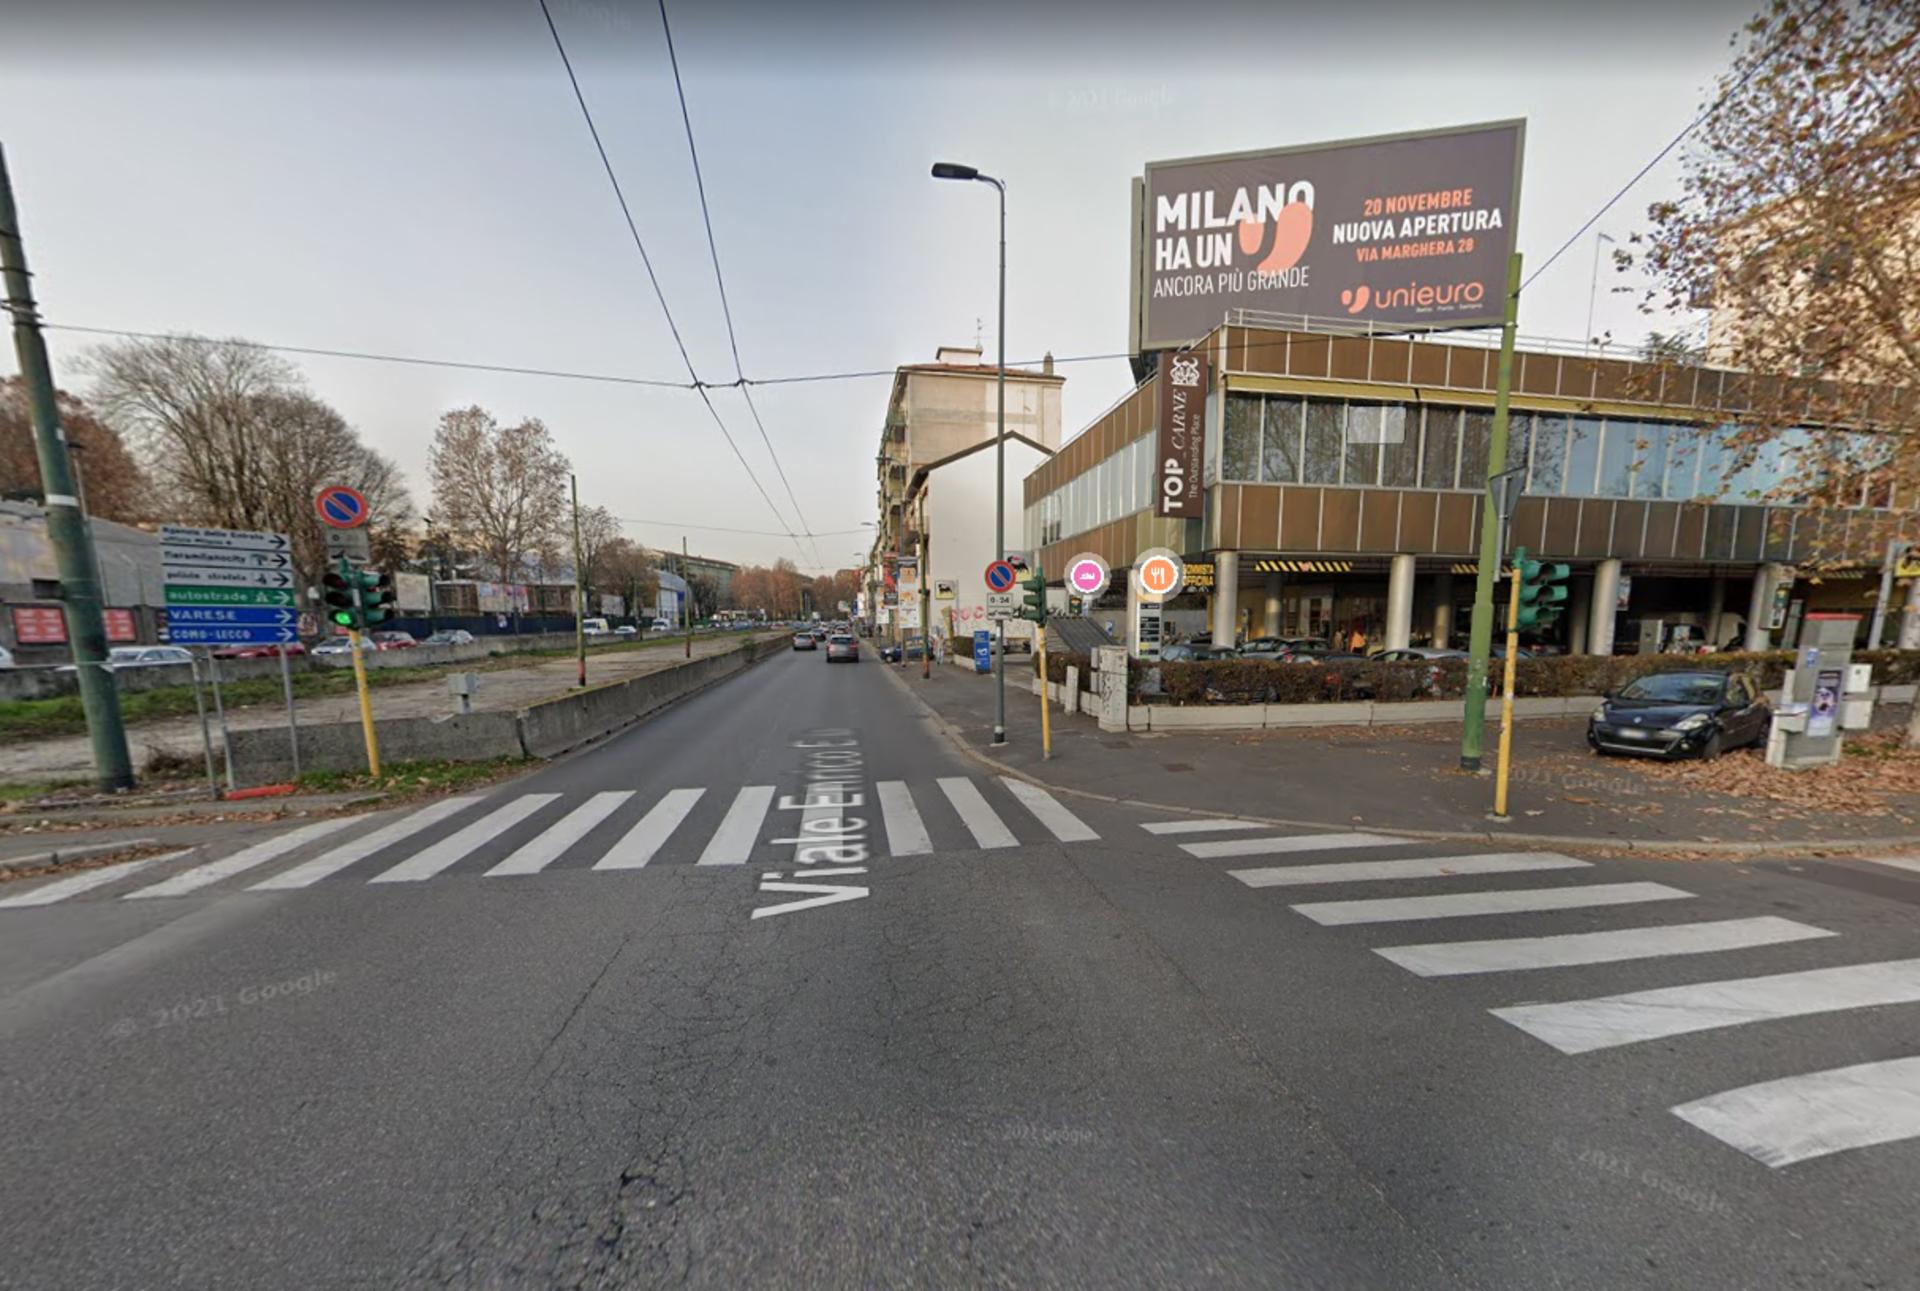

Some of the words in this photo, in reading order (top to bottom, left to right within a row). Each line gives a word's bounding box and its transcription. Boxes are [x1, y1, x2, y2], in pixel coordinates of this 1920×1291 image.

[1156, 180, 1315, 233] MILANO
[1364, 197, 1382, 217] 20
[1385, 188, 1472, 213] NOVEMBRE
[1332, 219, 1395, 244] NUOVA
[1399, 208, 1503, 238] APERTURA
[1155, 237, 1191, 271] HA
[1196, 232, 1233, 268] UN
[1356, 246, 1376, 263] VIA
[1379, 240, 1454, 260] MARGHERA
[1458, 237, 1474, 254] 28
[1153, 274, 1214, 299] ANCORA
[1218, 267, 1243, 294] PIÙ
[1246, 266, 1310, 291] GRANDE
[1375, 281, 1484, 310] unieuro
[1171, 388, 1188, 450] CARNE
[1190, 413, 1201, 436] Place
[1189, 436, 1202, 483] Outstanding
[1163, 457, 1184, 513] TOP
[1189, 483, 1198, 498] The
[168, 590, 249, 602] autostrade
[169, 609, 238, 621] VARESE
